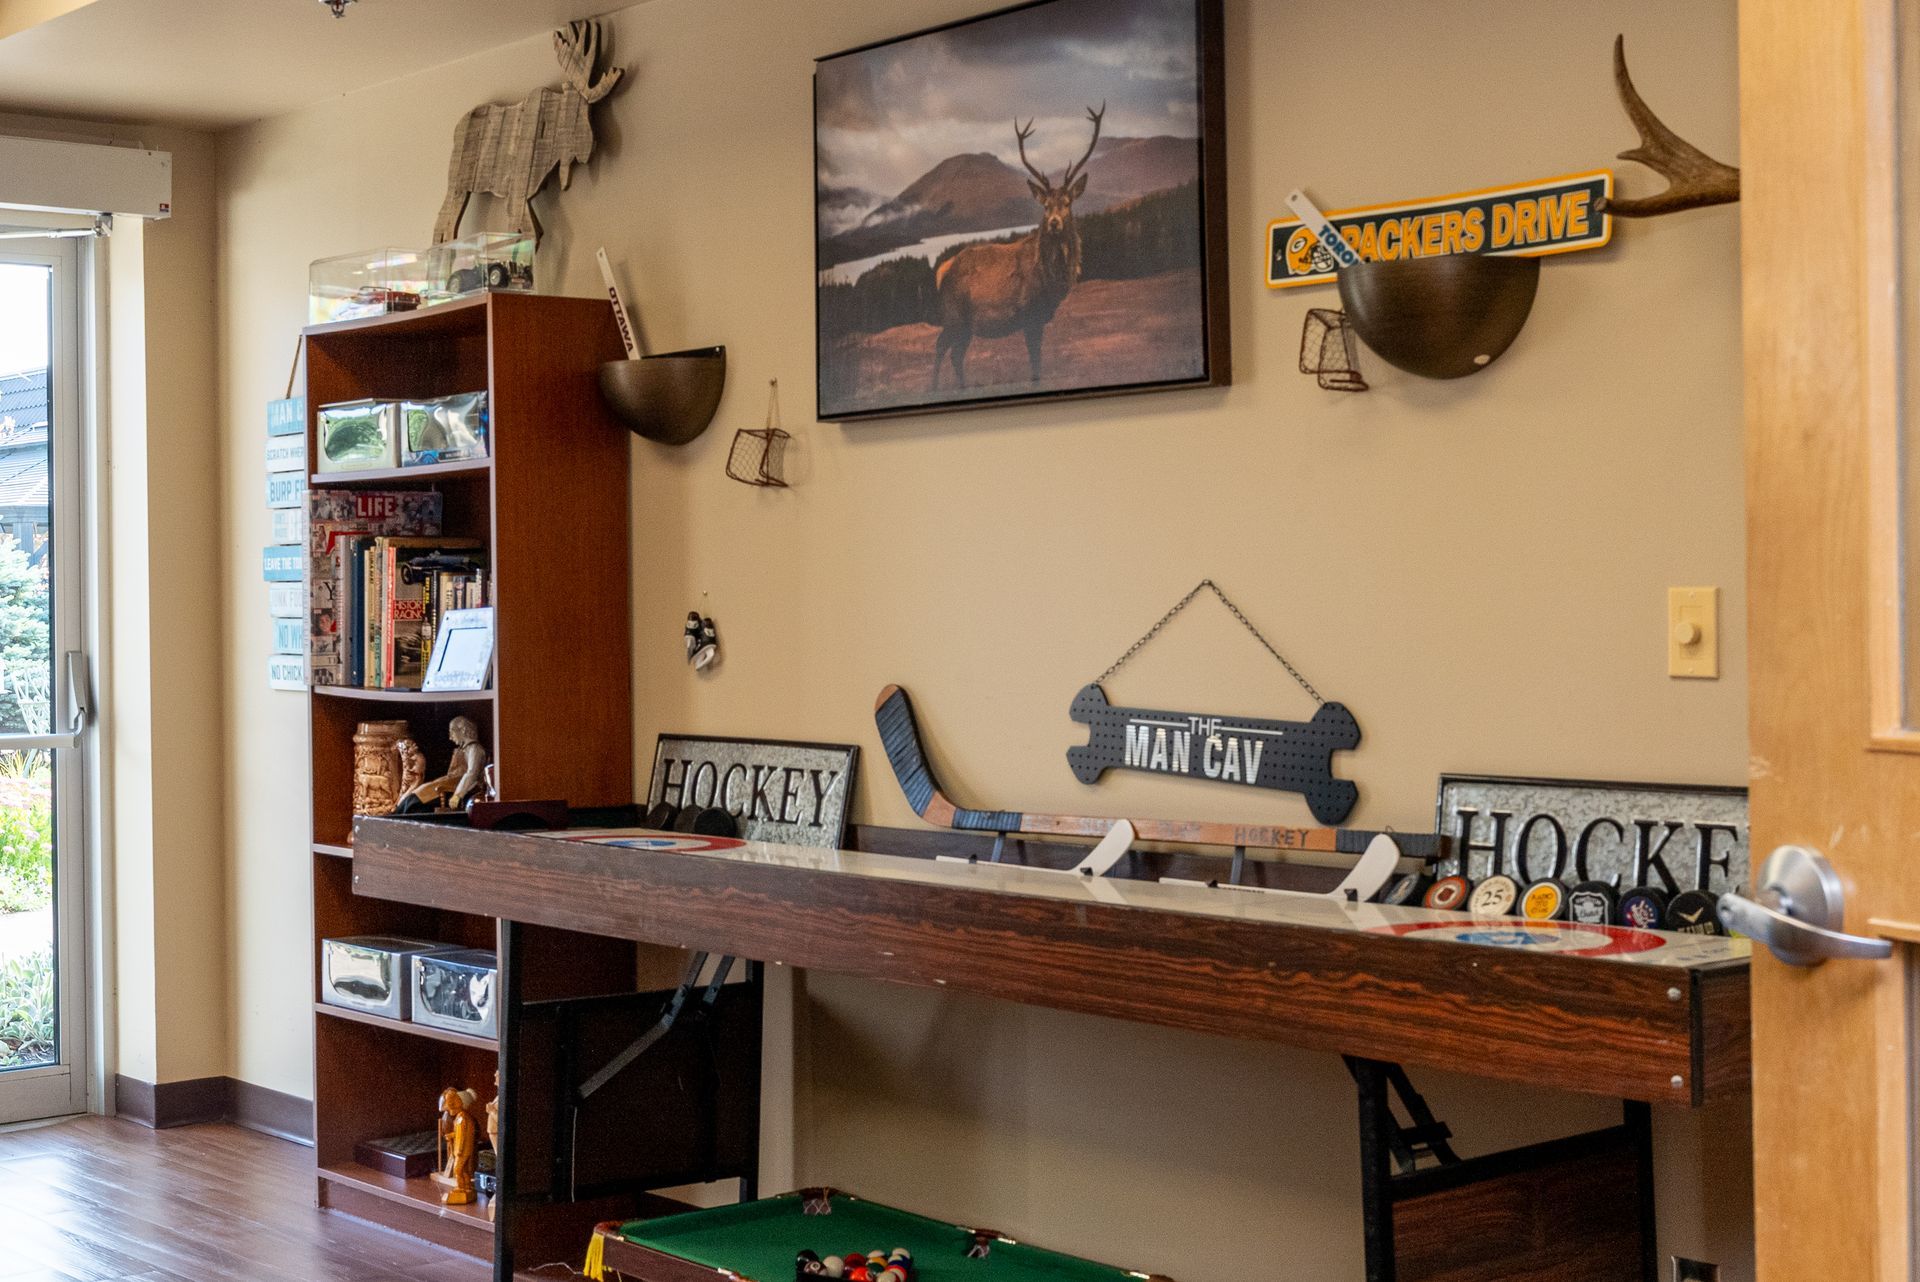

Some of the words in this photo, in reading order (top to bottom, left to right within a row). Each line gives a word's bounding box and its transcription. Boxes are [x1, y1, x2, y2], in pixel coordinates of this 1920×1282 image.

[1340, 206, 1486, 263] PACKERS
[1491, 189, 1591, 249] DRIVE
[1319, 224, 1359, 265] TORO
[608, 287, 634, 353] OTTAWA
[266, 448, 289, 461] SCRATCH
[270, 480, 292, 502] BURP
[357, 497, 396, 517] LIFE
[395, 600, 422, 610] HISTOR
[279, 624, 288, 649] NO
[271, 664, 281, 681] NO
[1188, 716, 1222, 737] THE
[1125, 724, 1191, 774] MAN
[1203, 734, 1264, 785] CAV
[661, 758, 839, 828] HOCKEY
[1234, 826, 1310, 849] HOCKEY
[1456, 807, 1740, 899] HOCKE
[1481, 888, 1504, 907] 25
